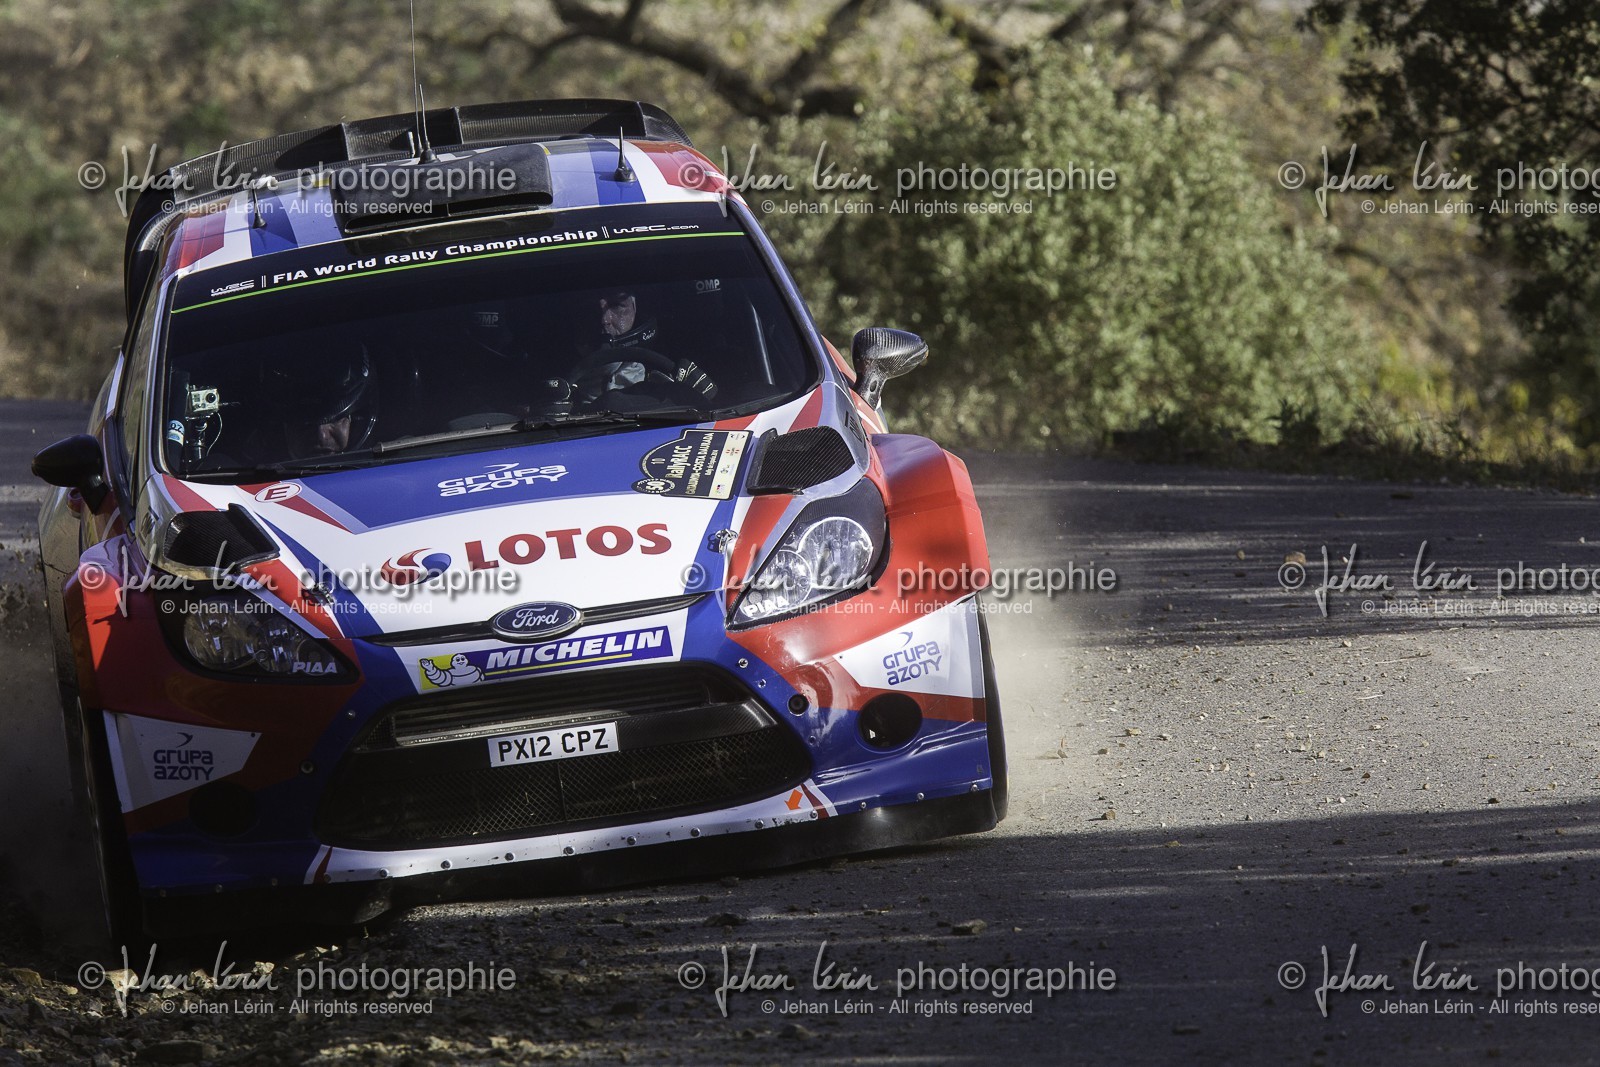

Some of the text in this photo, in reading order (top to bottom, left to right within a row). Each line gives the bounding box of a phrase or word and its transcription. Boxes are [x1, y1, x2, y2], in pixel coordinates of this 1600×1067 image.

[273, 270, 308, 284] FIA
[314, 258, 376, 276] World
[384, 249, 438, 265] Rally
[445, 228, 598, 256] Championship
[695, 278, 720, 291] OMP
[475, 314, 499, 324] MP
[665, 445, 693, 479] RallyRACC
[645, 480, 666, 491] 50
[465, 523, 672, 571] LOTOS
[512, 606, 560, 629] Ford
[486, 629, 664, 669] MICHELIN
[292, 661, 338, 674] PIAA
[498, 728, 609, 762] PX12 CPZ
